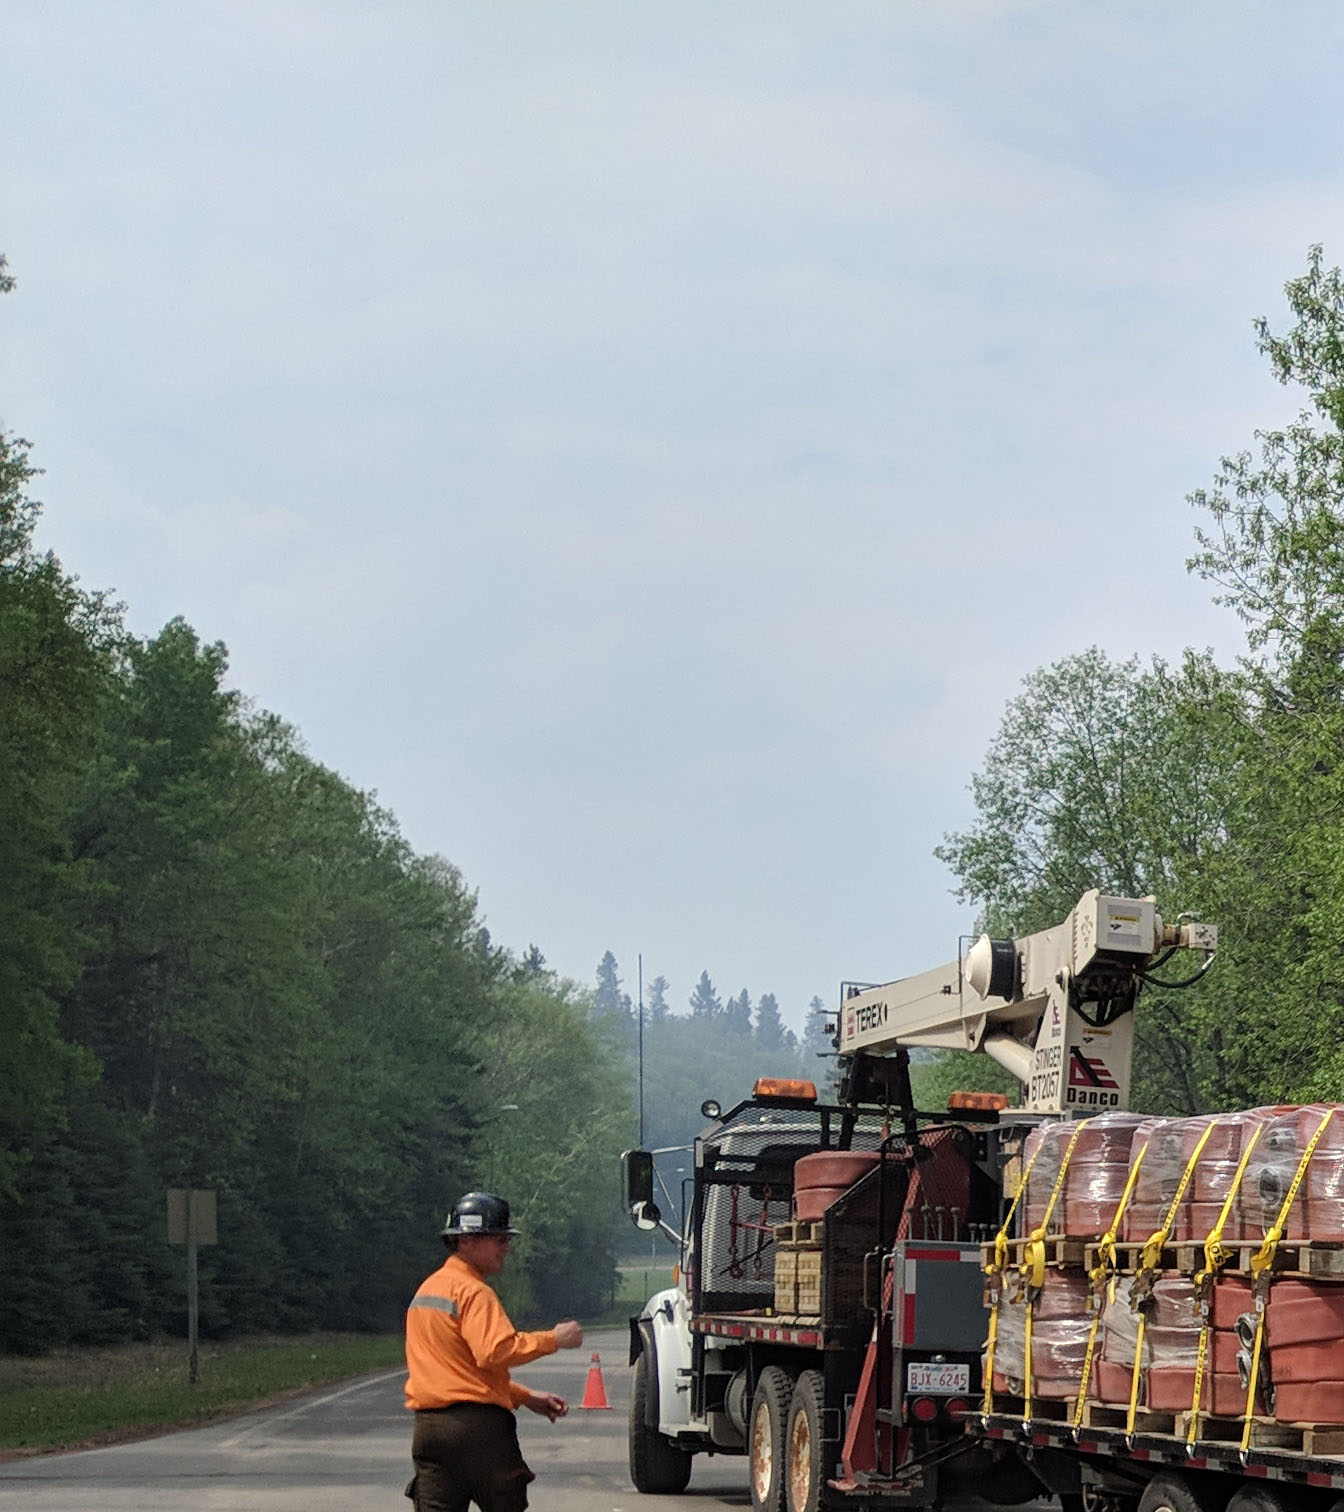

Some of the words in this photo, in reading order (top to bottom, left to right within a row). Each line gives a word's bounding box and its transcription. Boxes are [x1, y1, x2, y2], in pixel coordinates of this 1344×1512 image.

[856, 1001, 883, 1033] TEREX
[1035, 1044, 1062, 1072] STINGER
[1031, 1070, 1060, 1102] BT2057
[1066, 1087, 1119, 1106] Danco
